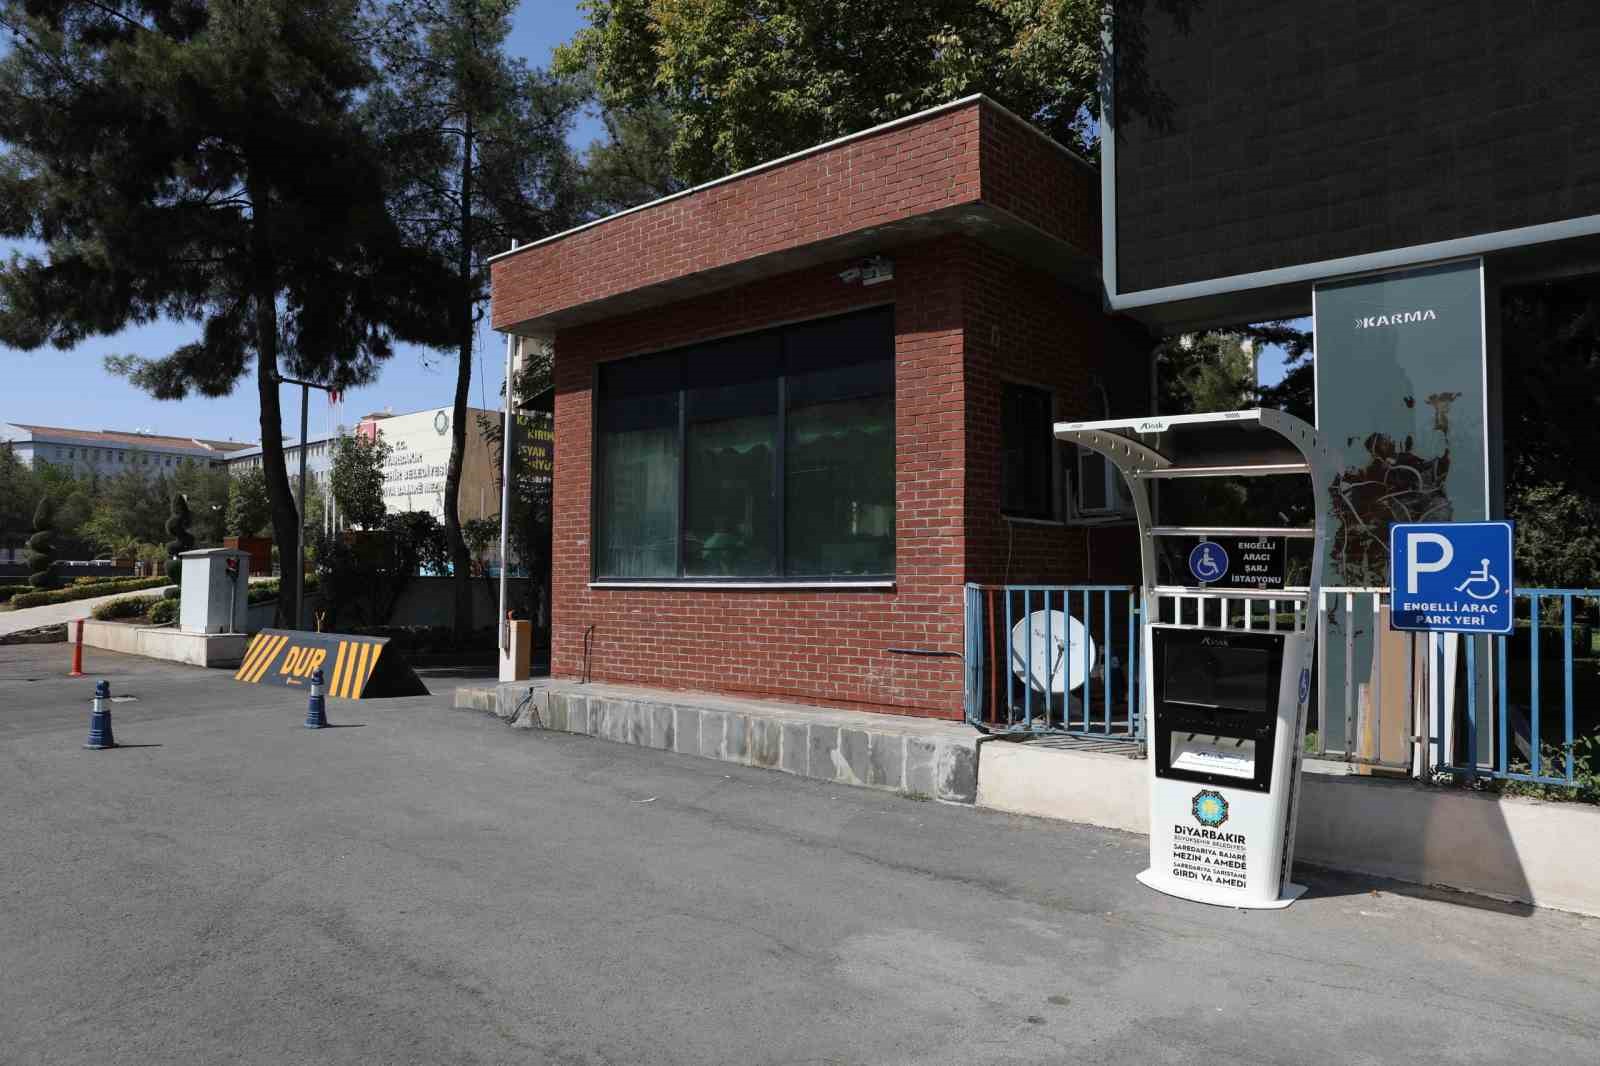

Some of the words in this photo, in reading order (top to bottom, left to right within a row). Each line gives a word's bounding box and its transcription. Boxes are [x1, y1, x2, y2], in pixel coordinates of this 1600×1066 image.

[1363, 309, 1437, 329] KARMA
[1238, 541, 1276, 550] ENGELLİ
[1243, 553, 1270, 561] ARACI
[1407, 532, 1454, 594] P
[1231, 574, 1282, 584] İSTASYONU
[1403, 601, 1458, 612] ENGELLİ
[1461, 603, 1498, 614] ARAÇ
[1416, 615, 1452, 625] PARK
[1454, 614, 1485, 626] YERİ
[279, 646, 327, 678] DUR
[1201, 873, 1213, 882] YA
